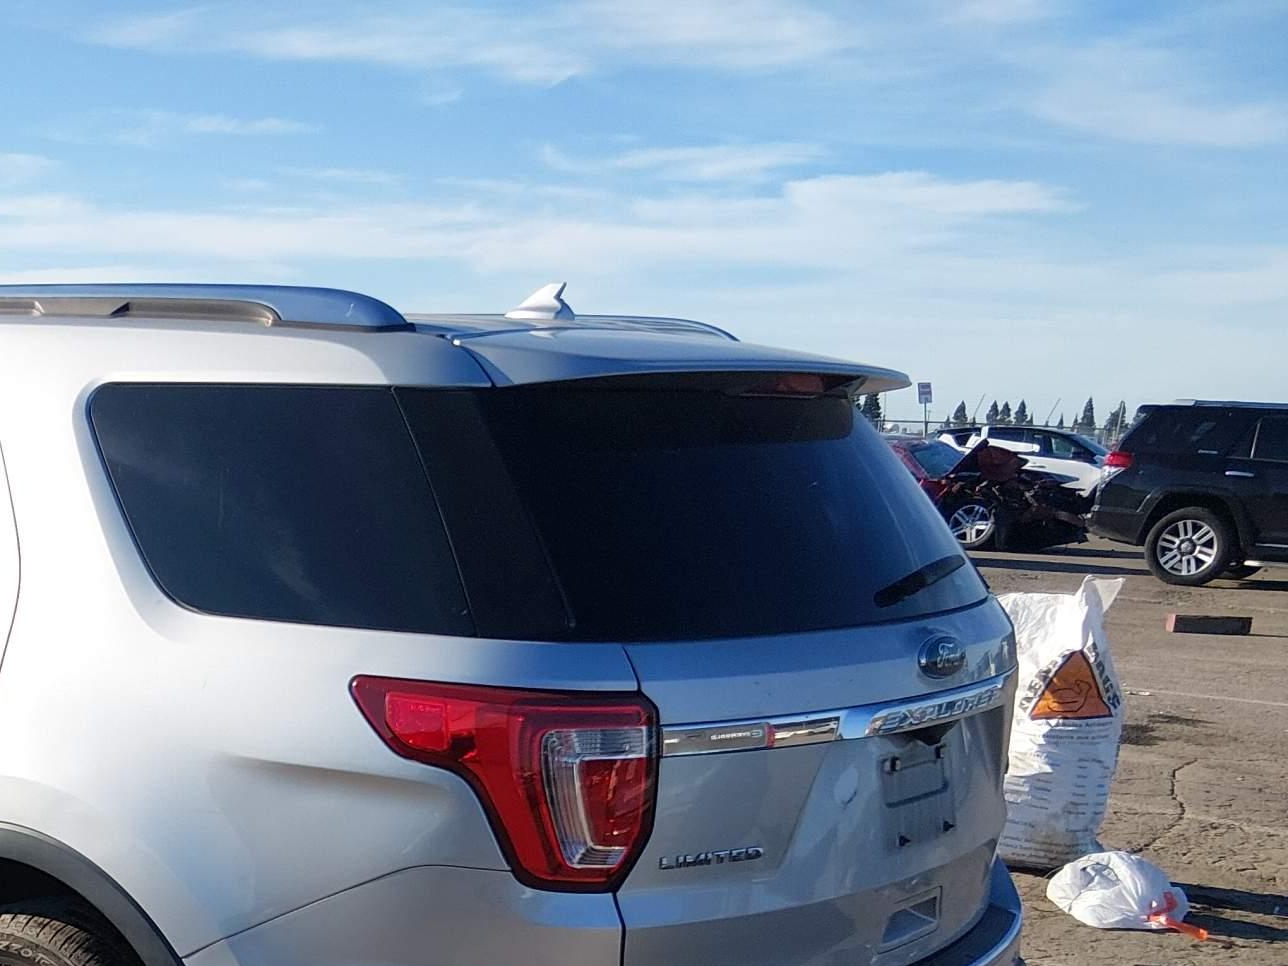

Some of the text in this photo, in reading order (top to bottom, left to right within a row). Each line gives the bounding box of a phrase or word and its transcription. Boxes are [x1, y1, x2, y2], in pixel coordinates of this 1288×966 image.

[936, 642, 967, 668] Ford
[878, 689, 1001, 734] EXPLORER
[658, 846, 764, 870] LIMITED
